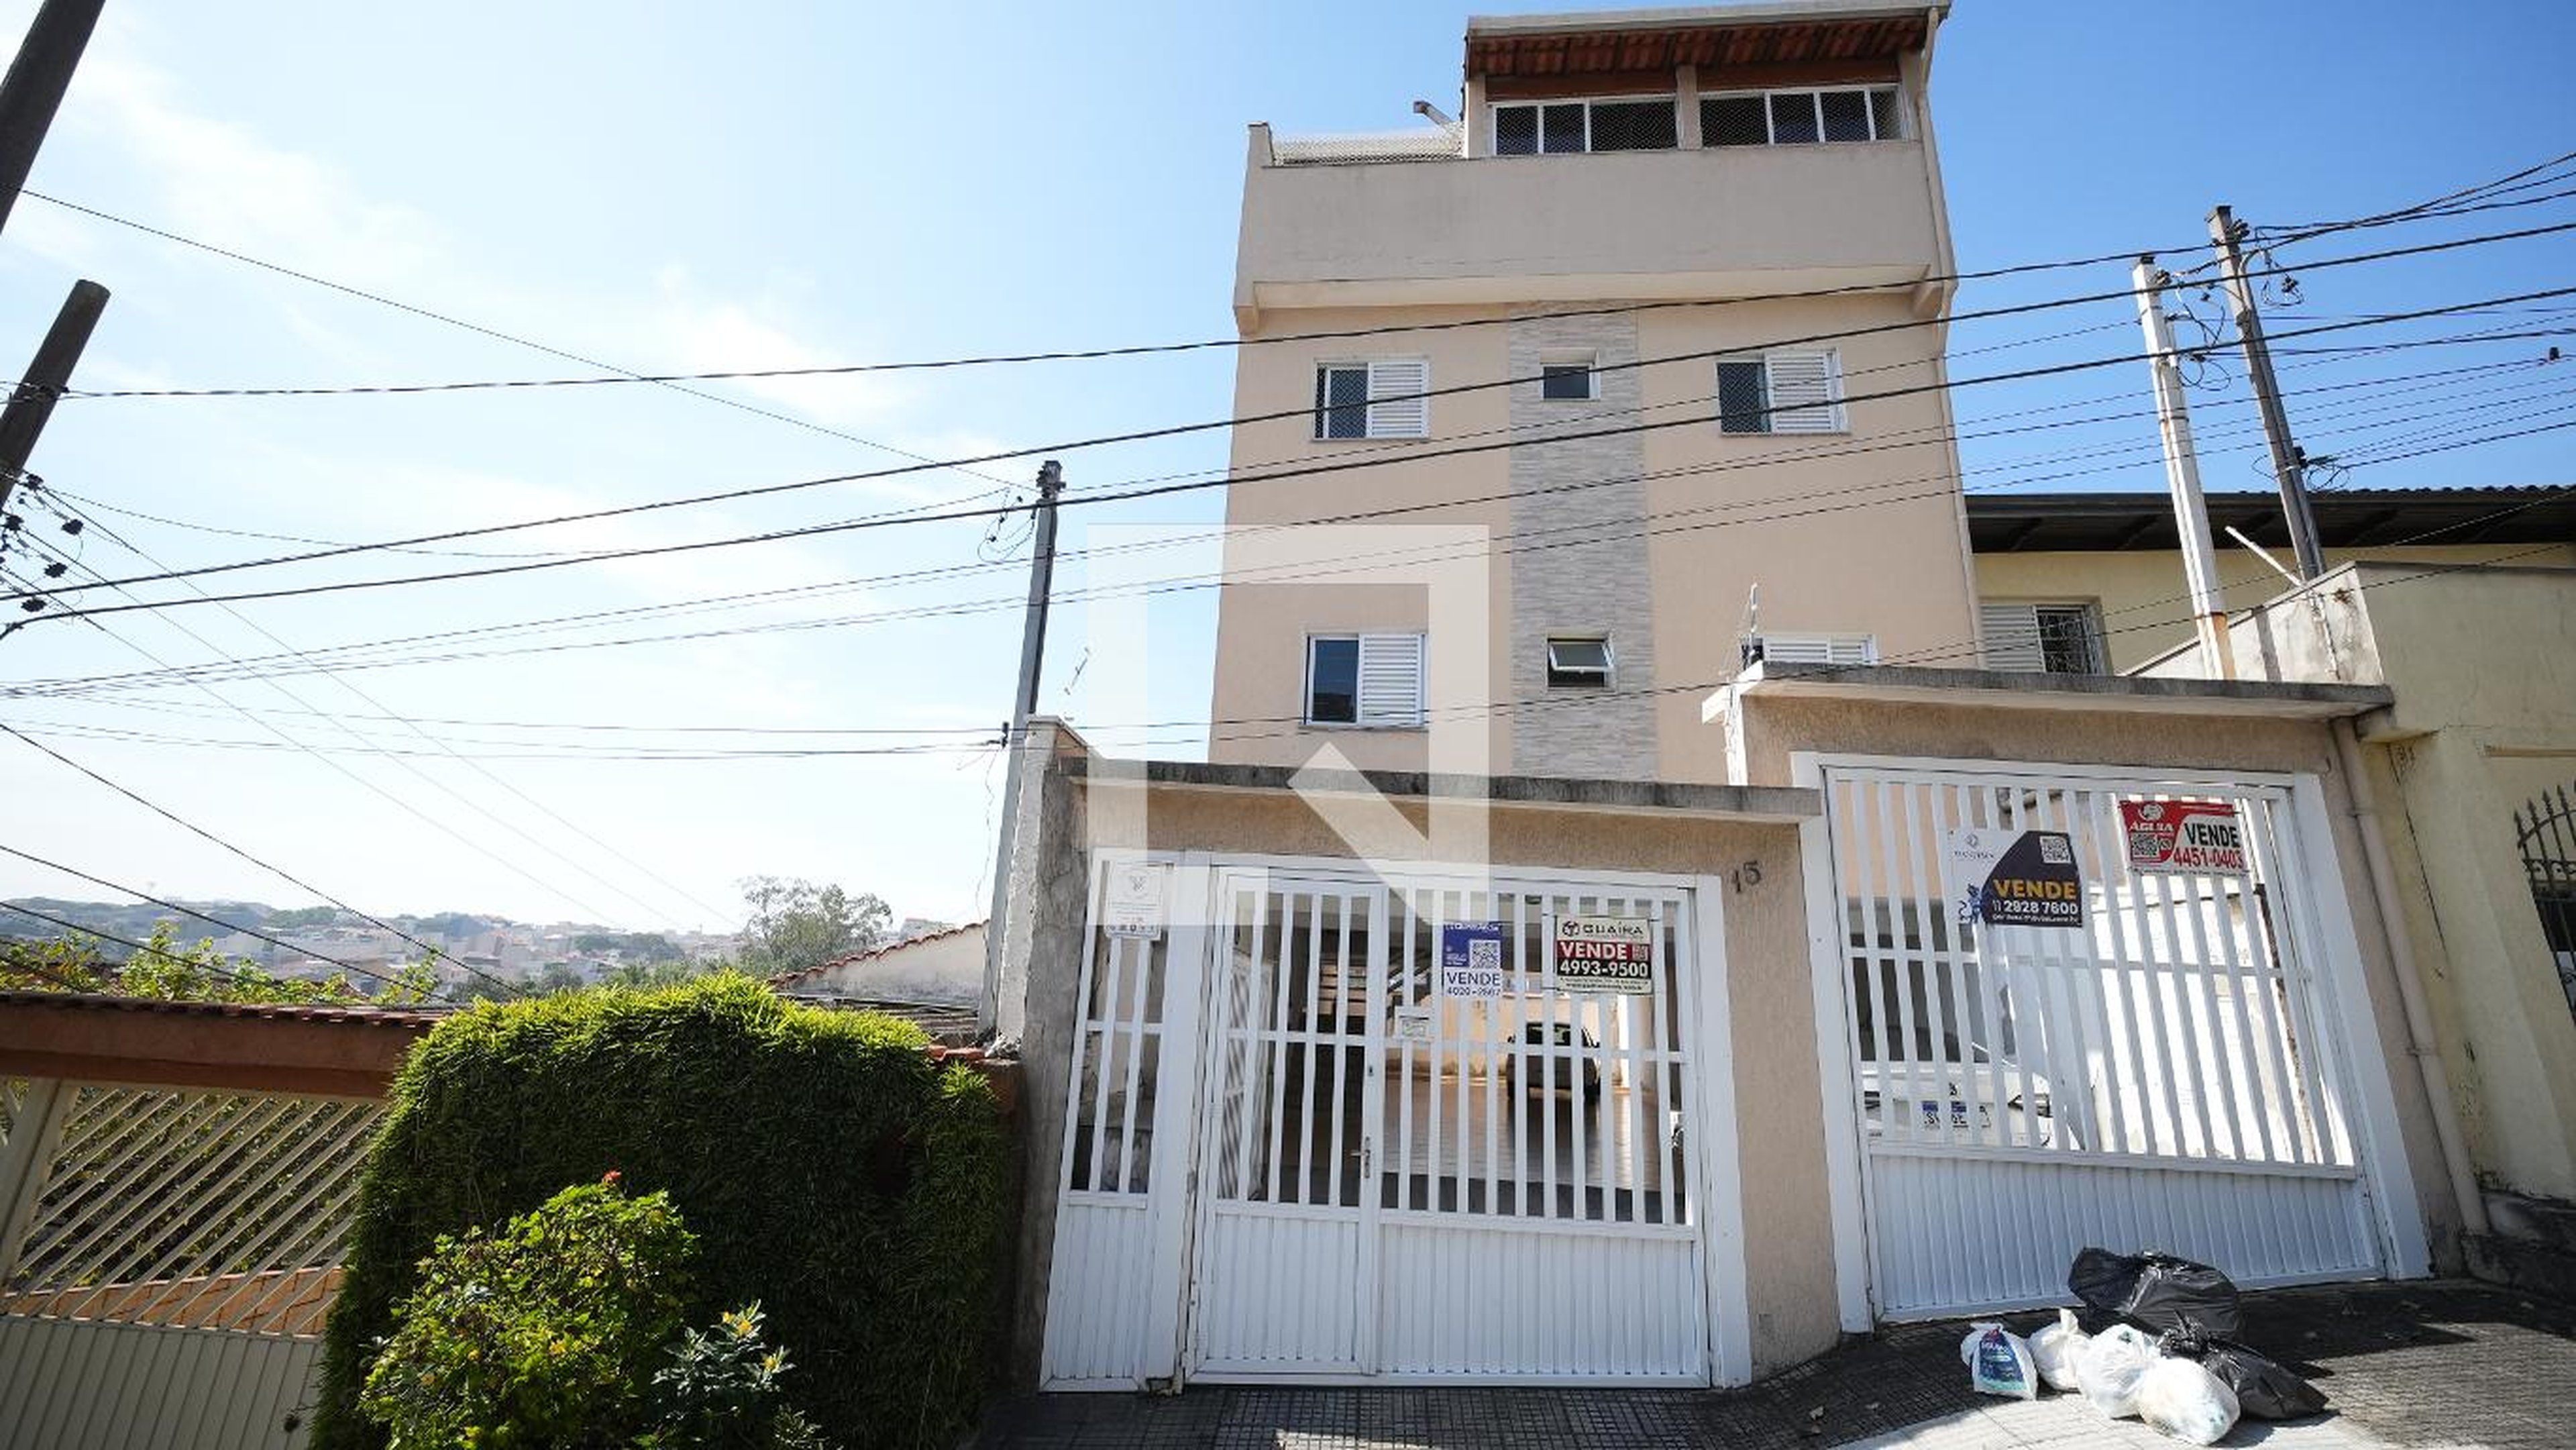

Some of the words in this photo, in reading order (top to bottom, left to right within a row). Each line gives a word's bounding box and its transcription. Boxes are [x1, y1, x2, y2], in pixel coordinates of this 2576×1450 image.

[2184, 823, 2241, 847] VENDE
[2174, 847, 2245, 870] 4451-0403
[1733, 860, 1762, 894] 15
[1992, 879, 2077, 900] VENDE
[1560, 941, 1627, 960] VENDE
[1446, 972, 1501, 986] VENDE
[1560, 960, 1648, 977] 4993-9500
